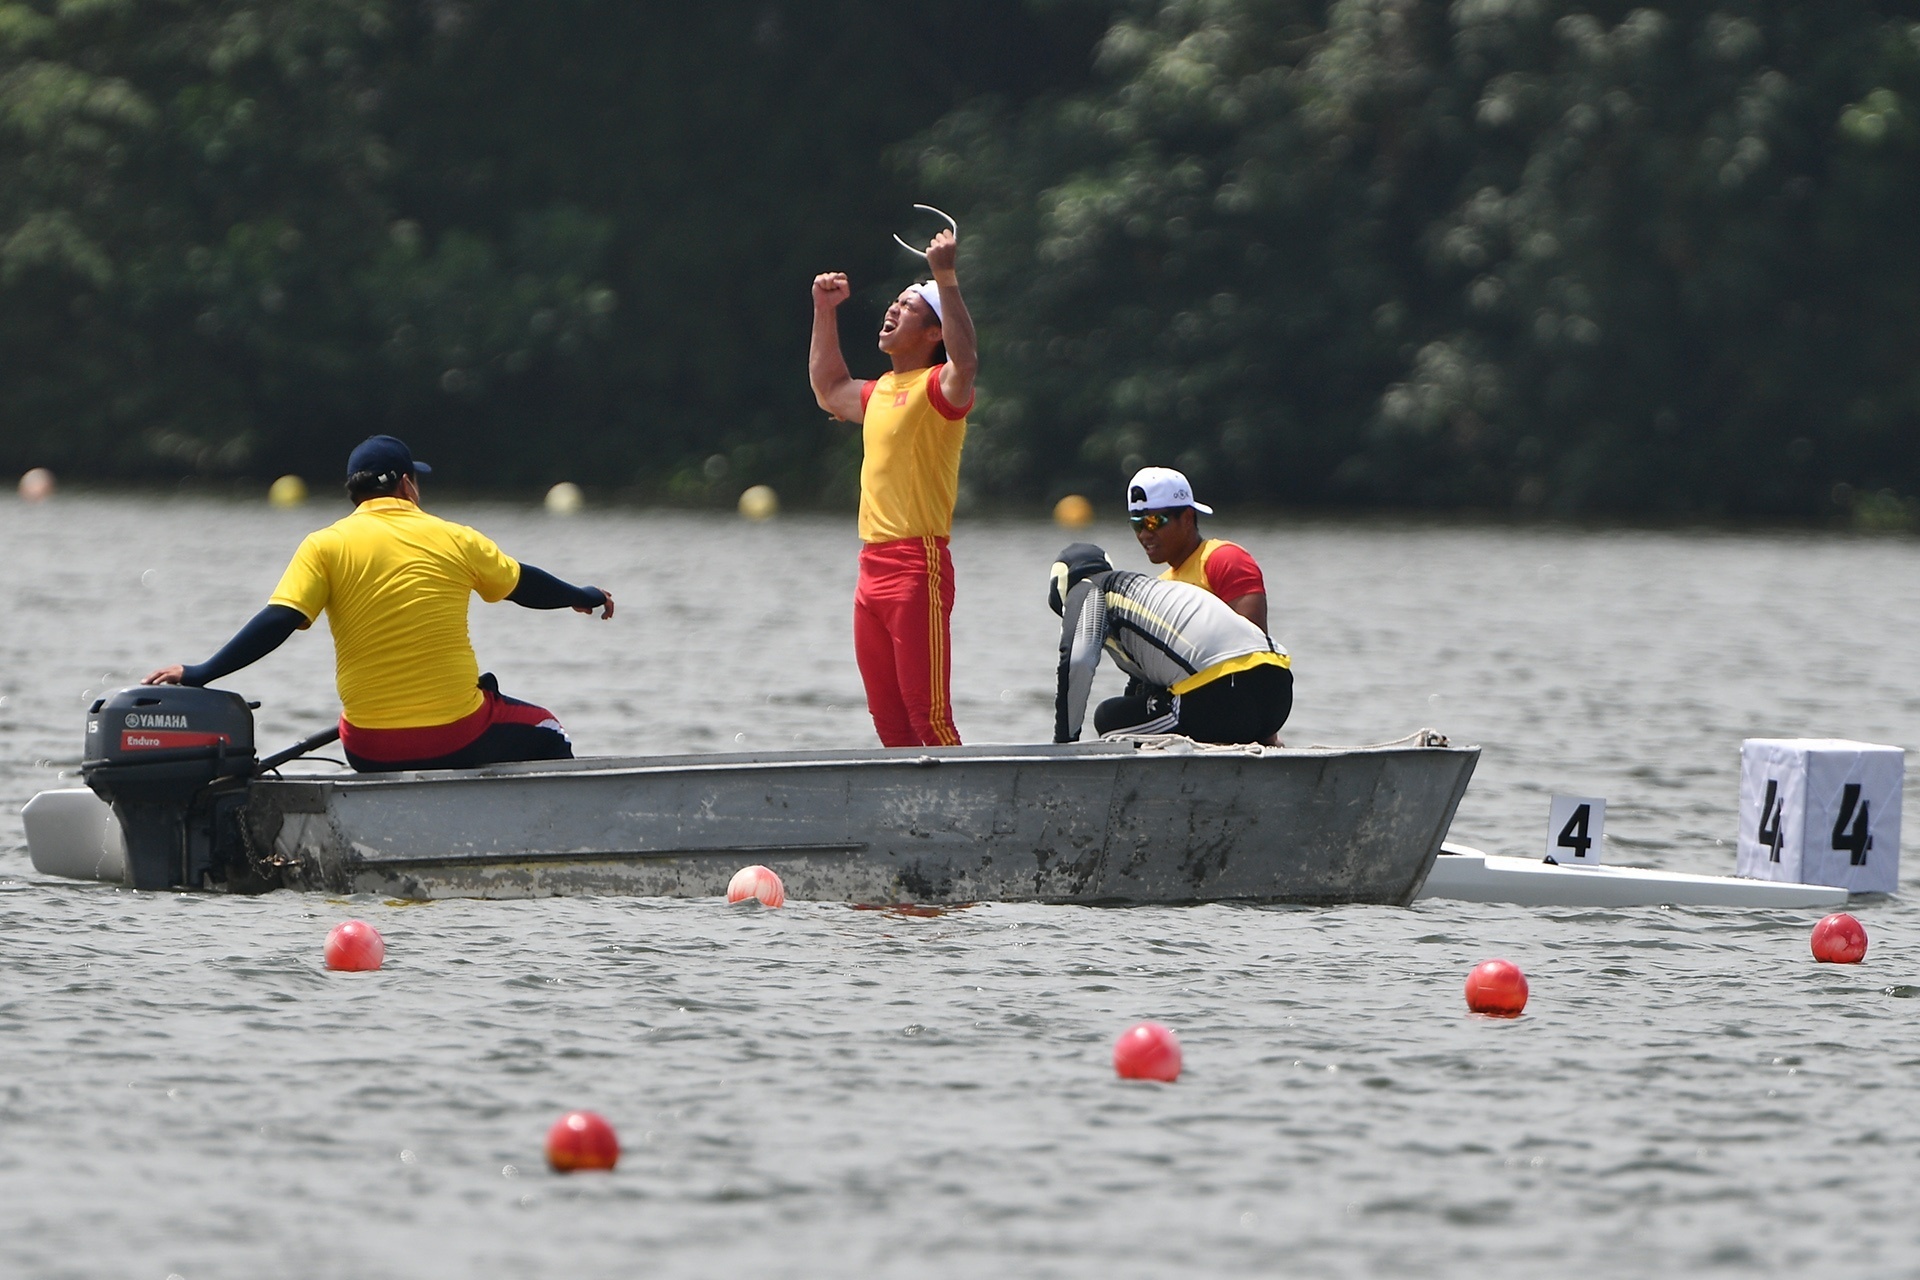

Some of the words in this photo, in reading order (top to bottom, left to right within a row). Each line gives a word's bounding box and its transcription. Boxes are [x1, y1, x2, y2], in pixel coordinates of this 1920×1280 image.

[88, 720, 99, 733] 15
[140, 714, 187, 728] YAMAHA
[127, 736, 160, 746] Enduro
[1557, 803, 1592, 858] 4
[1759, 779, 1784, 863] 4
[1831, 783, 1873, 865] 4
